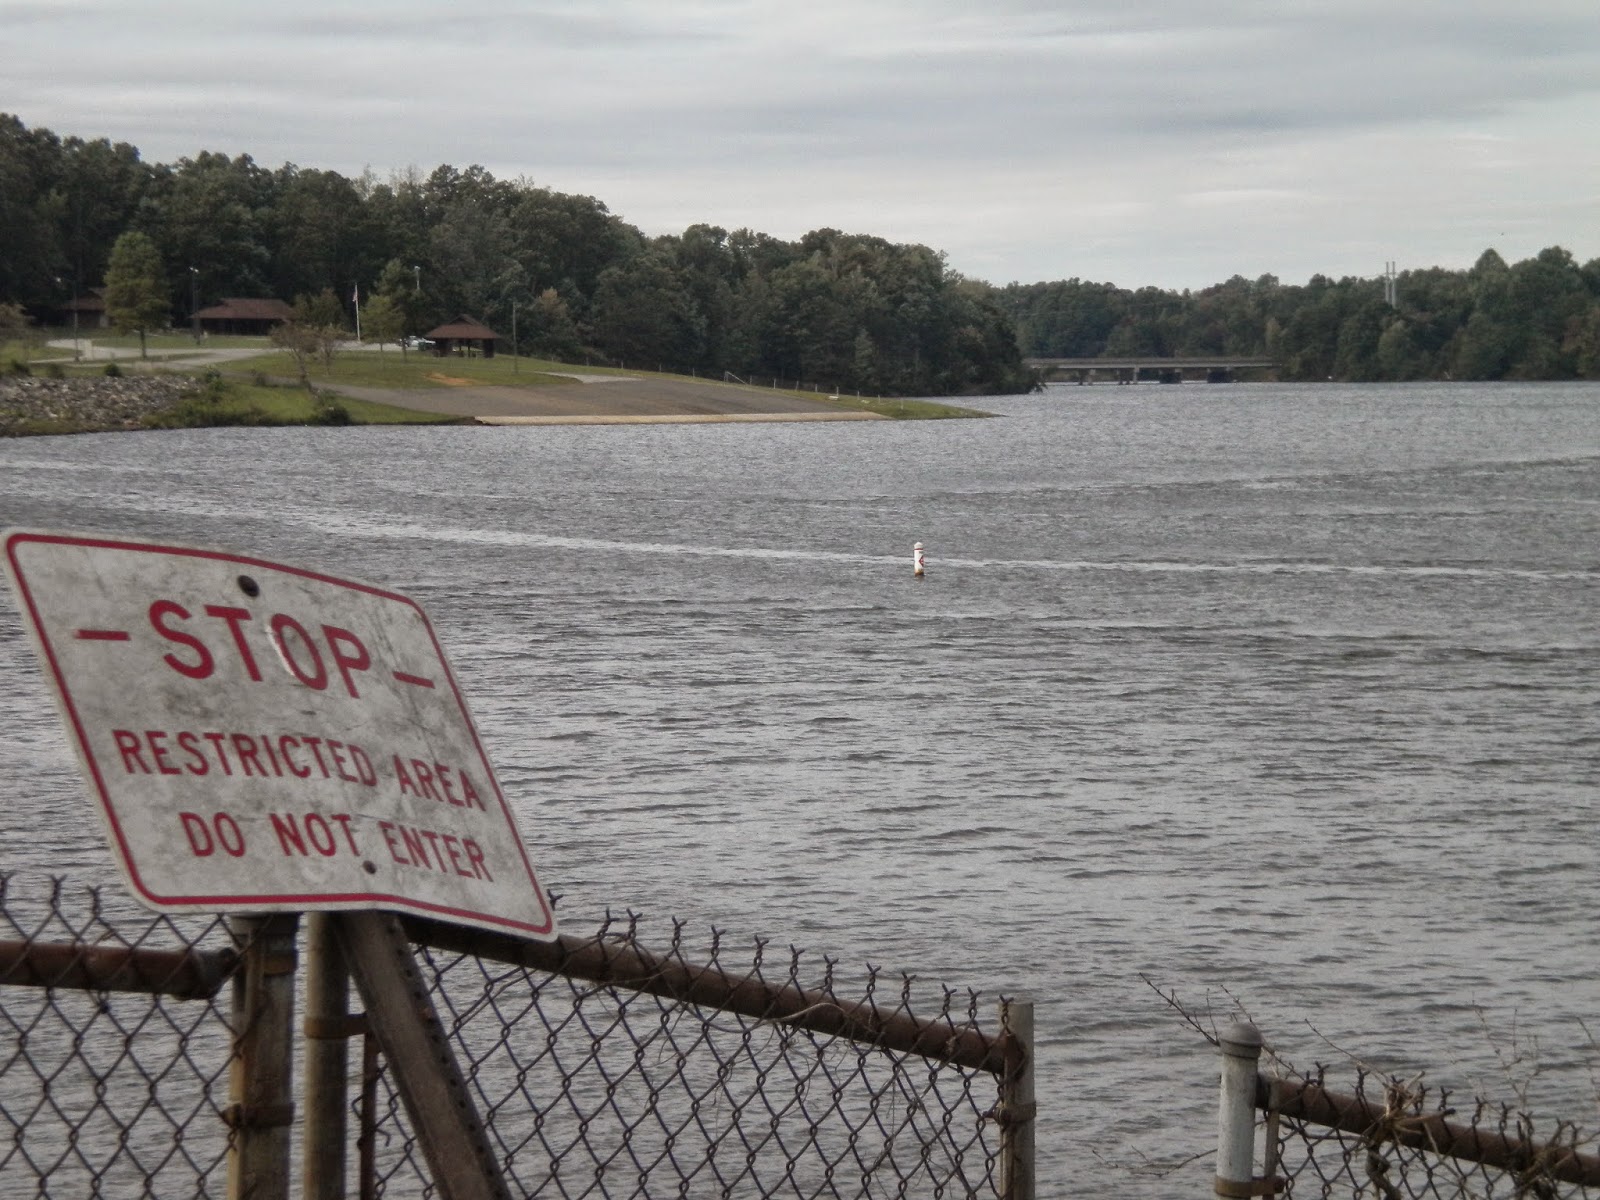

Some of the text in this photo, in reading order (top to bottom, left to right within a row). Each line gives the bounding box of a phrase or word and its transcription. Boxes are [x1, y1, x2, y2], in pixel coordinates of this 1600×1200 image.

[112, 729, 486, 812] RESTRICTED AREA
[178, 812, 494, 882] DO NOT ENTER
